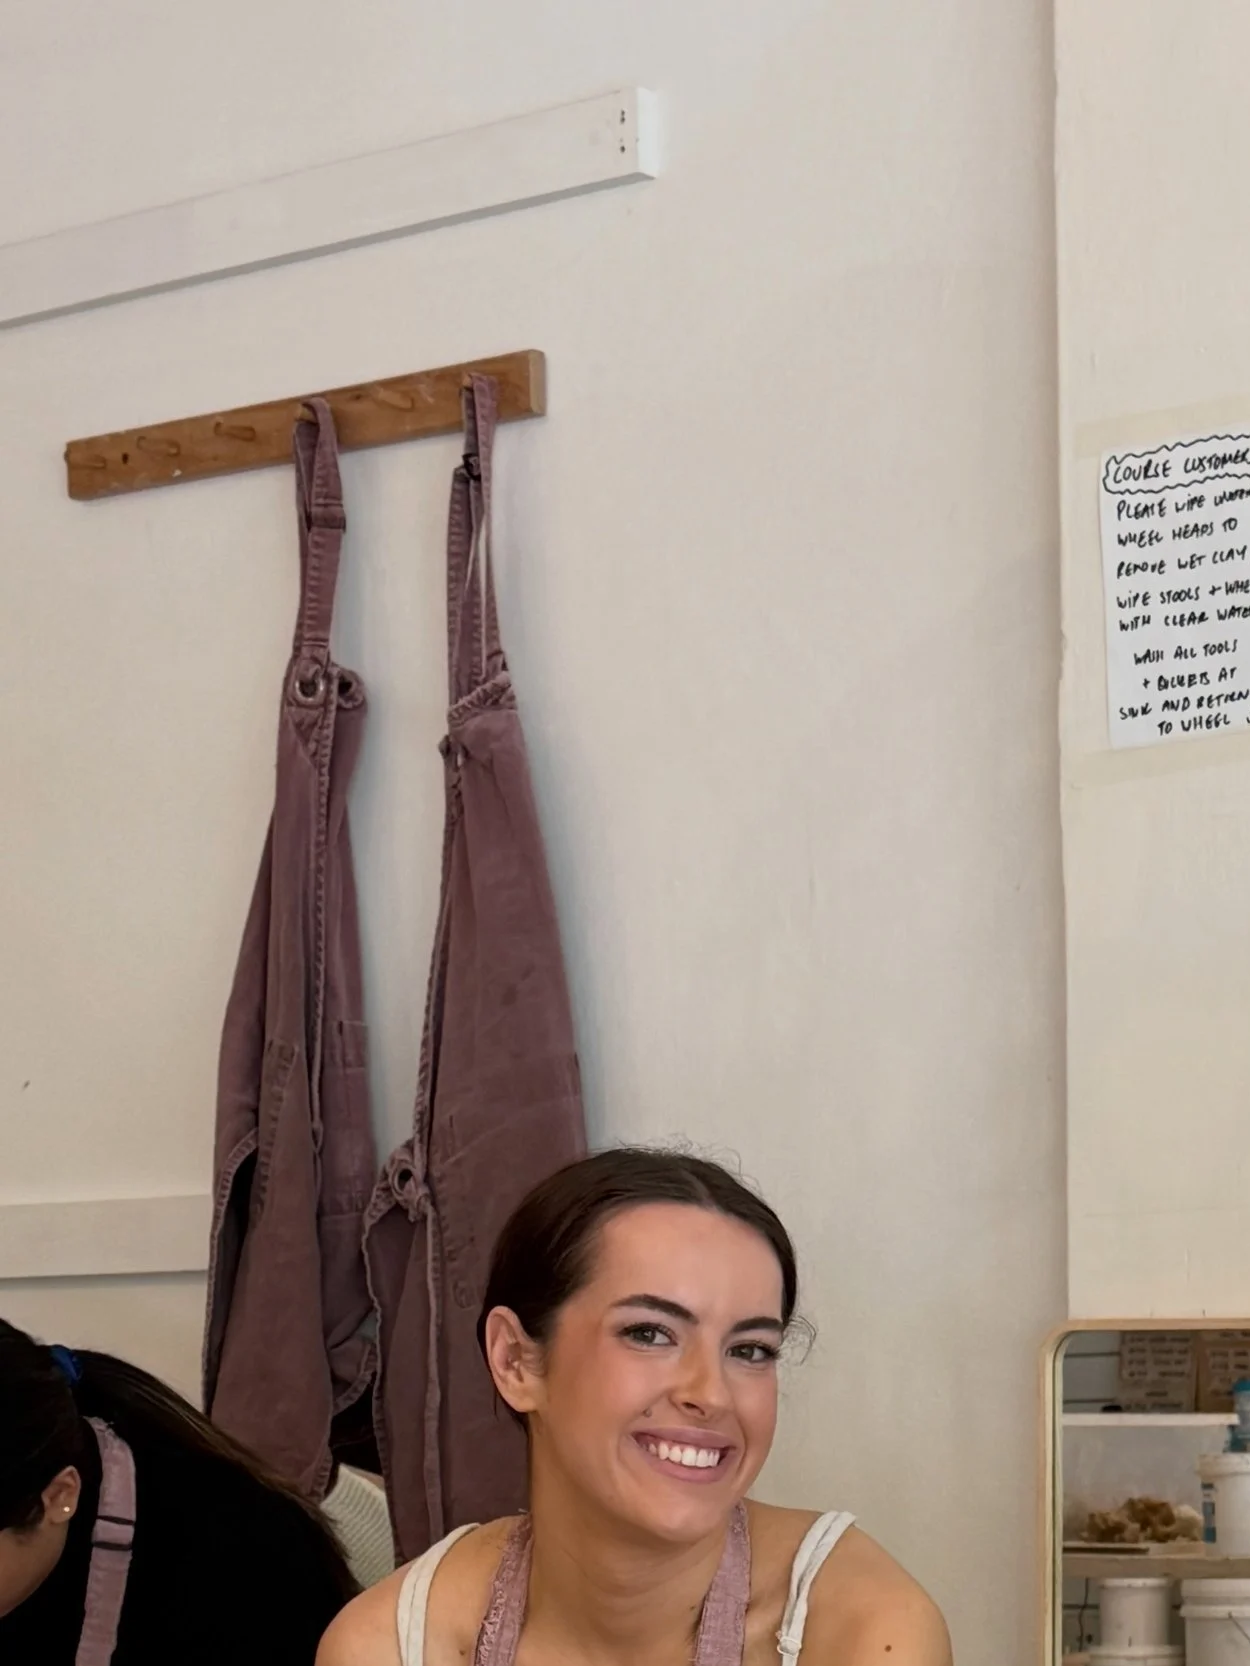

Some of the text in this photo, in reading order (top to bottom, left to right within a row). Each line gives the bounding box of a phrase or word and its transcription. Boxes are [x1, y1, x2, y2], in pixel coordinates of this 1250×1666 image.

[1112, 458, 1172, 485] COURSE
[1116, 516, 1238, 549] WHEEL HEADS TO
[1116, 560, 1167, 580] REMOVE
[1177, 553, 1207, 570] WET
[1160, 586, 1201, 605] STOOLS
[1119, 614, 1151, 632] WITH
[1173, 645, 1197, 660] ALL
[1203, 639, 1238, 657] TOOLS
[1218, 667, 1237, 682] AT
[1119, 702, 1153, 721] SINK
[1161, 697, 1191, 712] AND
[1157, 712, 1231, 736] TO WHEEL
